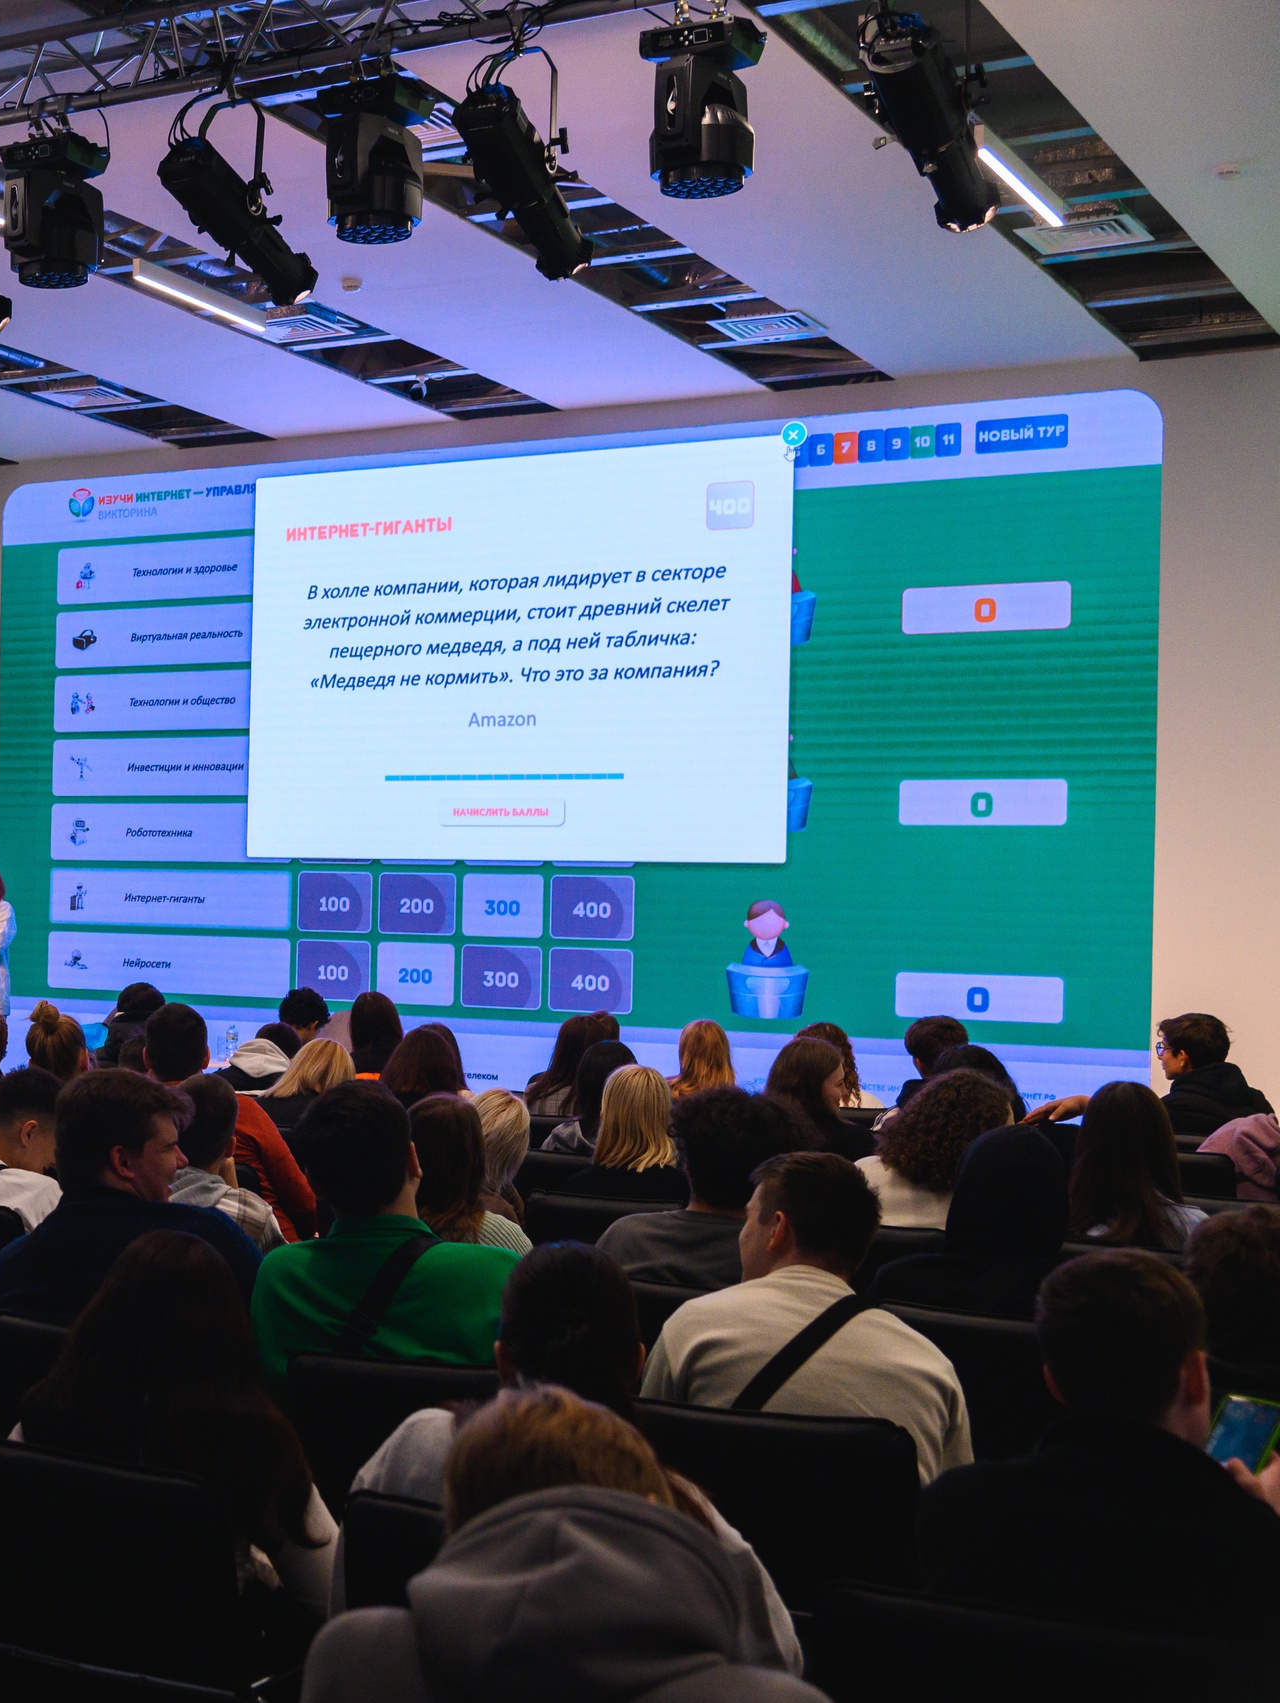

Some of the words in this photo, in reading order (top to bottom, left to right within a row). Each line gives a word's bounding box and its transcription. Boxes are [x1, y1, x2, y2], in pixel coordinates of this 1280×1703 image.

[978, 424, 1034, 443] НОВЫЙ
[1037, 425, 1065, 438] ТУР
[816, 444, 826, 456] 6
[840, 441, 851, 454] 7
[866, 439, 876, 452] 8
[891, 437, 902, 450] 9
[913, 435, 931, 448] 10
[942, 433, 955, 446] 11
[98, 494, 134, 505] ИЗУЧИ
[135, 489, 192, 503] ИНТЕРНЕТ
[709, 497, 751, 516] 400
[98, 506, 158, 520] ВИКТОРИНА
[286, 516, 453, 542] ИНТЕРНЕТ-ГИГАНТЫ
[132, 566, 184, 577] Технологии
[193, 563, 238, 576] здоровье
[307, 585, 318, 600] В
[321, 585, 369, 600] холле
[373, 580, 464, 597] компании,
[469, 575, 539, 593] которая
[543, 569, 632, 590] лидирует
[635, 569, 646, 583] в
[651, 565, 727, 583] секторе
[303, 609, 410, 631] электронной
[415, 607, 521, 626] коммерции,
[527, 605, 577, 620] стоит
[578, 597, 662, 621] древний
[666, 598, 731, 614] скелет
[973, 597, 997, 624] 0
[130, 632, 188, 644] Виртуальная
[189, 629, 243, 642] реальность
[329, 642, 421, 660] пещерного
[426, 639, 507, 657] медведя,
[512, 639, 522, 651] а
[527, 638, 561, 653] под
[566, 632, 601, 650] ней
[605, 630, 697, 648] табличка:
[310, 673, 395, 691] «Медведя
[399, 673, 421, 687] не
[424, 670, 513, 688] кормить».
[520, 667, 550, 683] Что
[554, 667, 584, 682] это
[588, 667, 608, 681] за
[613, 659, 720, 680] компания?
[129, 697, 180, 707] Технологии
[182, 698, 189, 706] и
[190, 695, 236, 706] общество
[468, 711, 537, 728] Amazon
[127, 762, 182, 773] Инвестиции
[184, 763, 190, 771] и
[192, 763, 245, 773] инновации
[453, 808, 510, 817] НАЧИСЛИТЬ
[512, 808, 549, 817] БАЛЛЫ
[970, 791, 994, 818] 0
[125, 827, 193, 838] Робототехника
[124, 893, 205, 904] Интернет-гиганты
[319, 896, 350, 912] 100
[399, 898, 434, 915] 200
[484, 900, 520, 916] 300
[572, 901, 611, 919] 400
[122, 958, 171, 969] Нейросети
[318, 965, 349, 981] 100
[398, 967, 433, 984] 200
[483, 971, 519, 988] 300
[571, 974, 610, 992] 400
[966, 986, 990, 1014] 0
